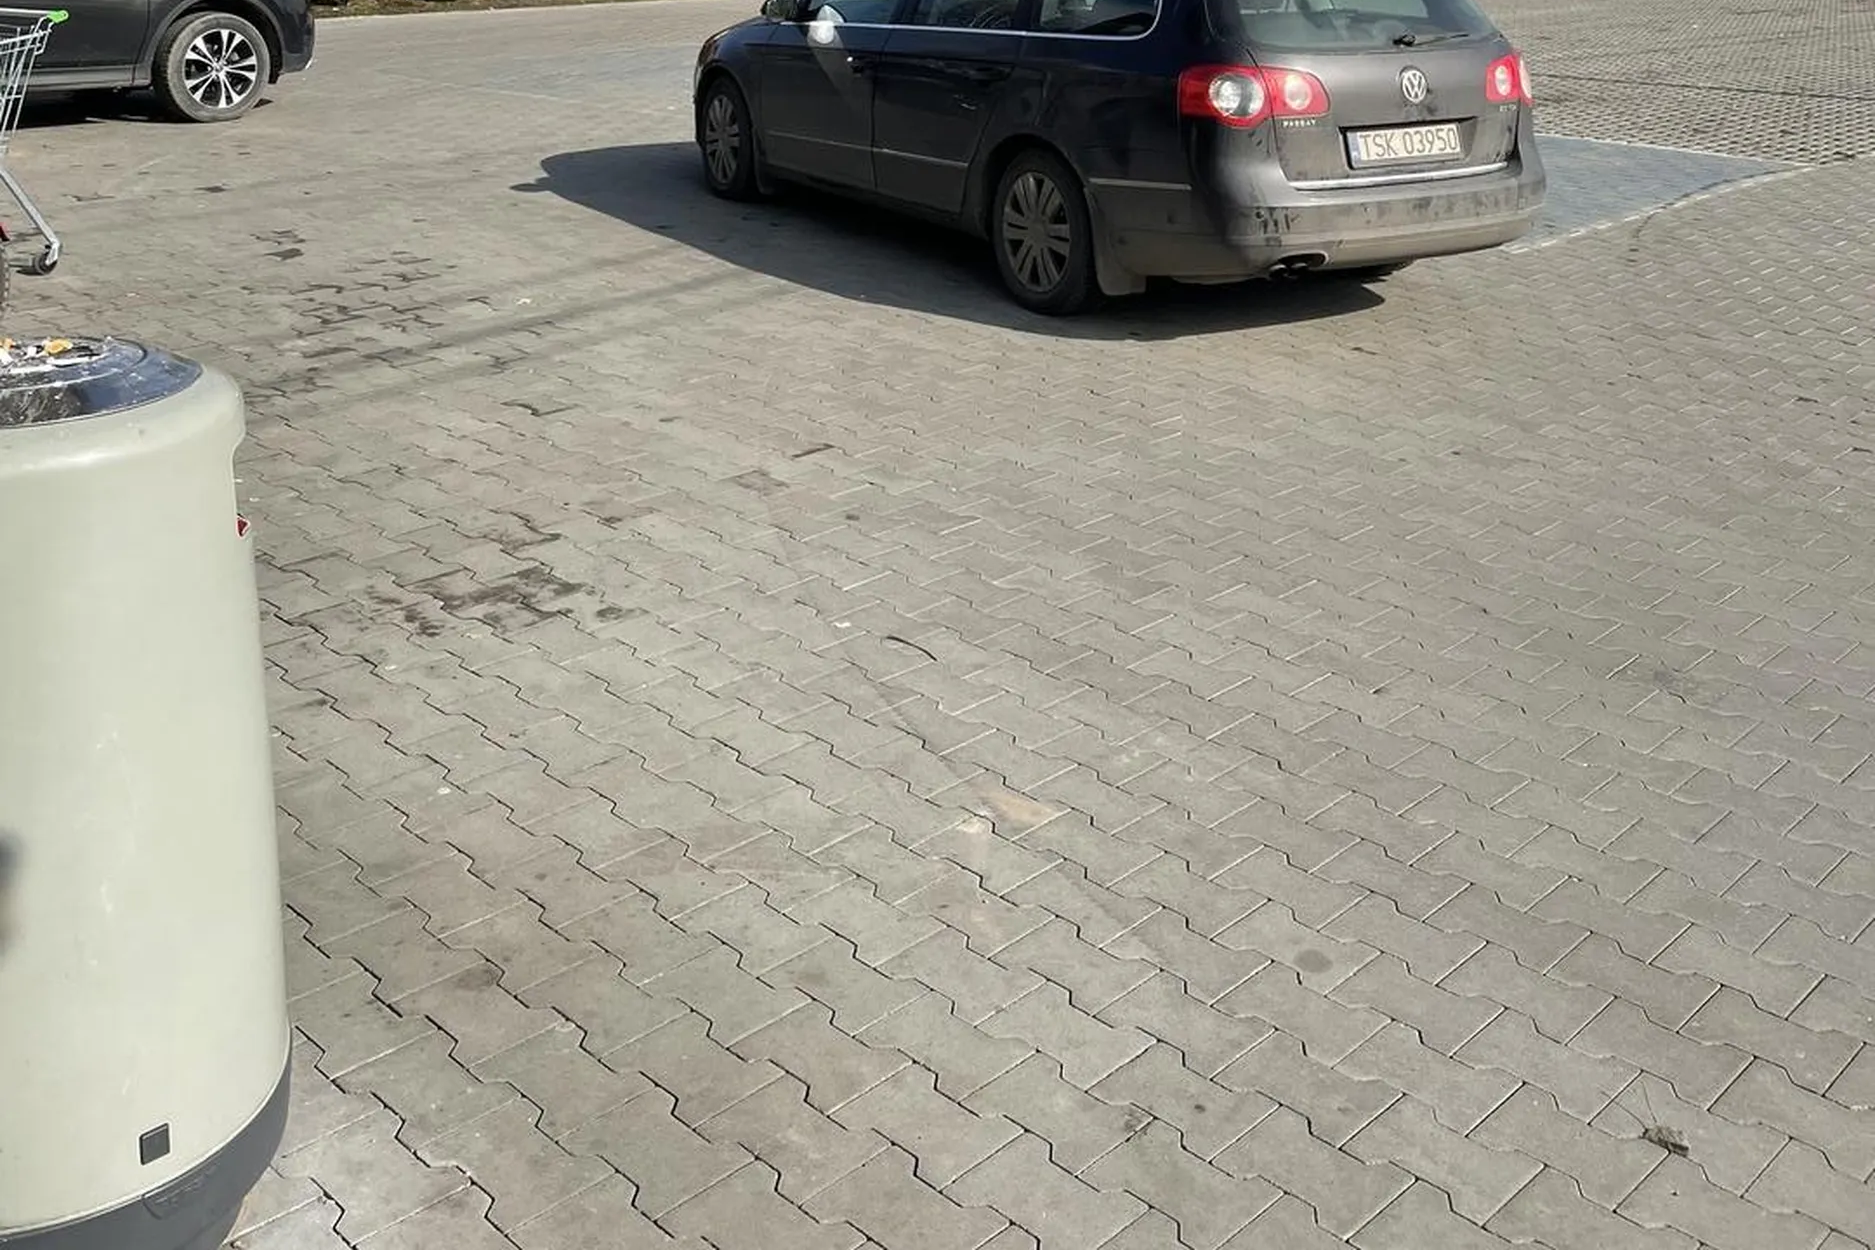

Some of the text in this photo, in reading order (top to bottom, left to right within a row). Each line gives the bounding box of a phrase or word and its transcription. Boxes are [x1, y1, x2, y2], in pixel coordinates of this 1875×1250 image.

[1402, 70, 1427, 103] VW
[1359, 127, 1458, 159] TSK 03950
